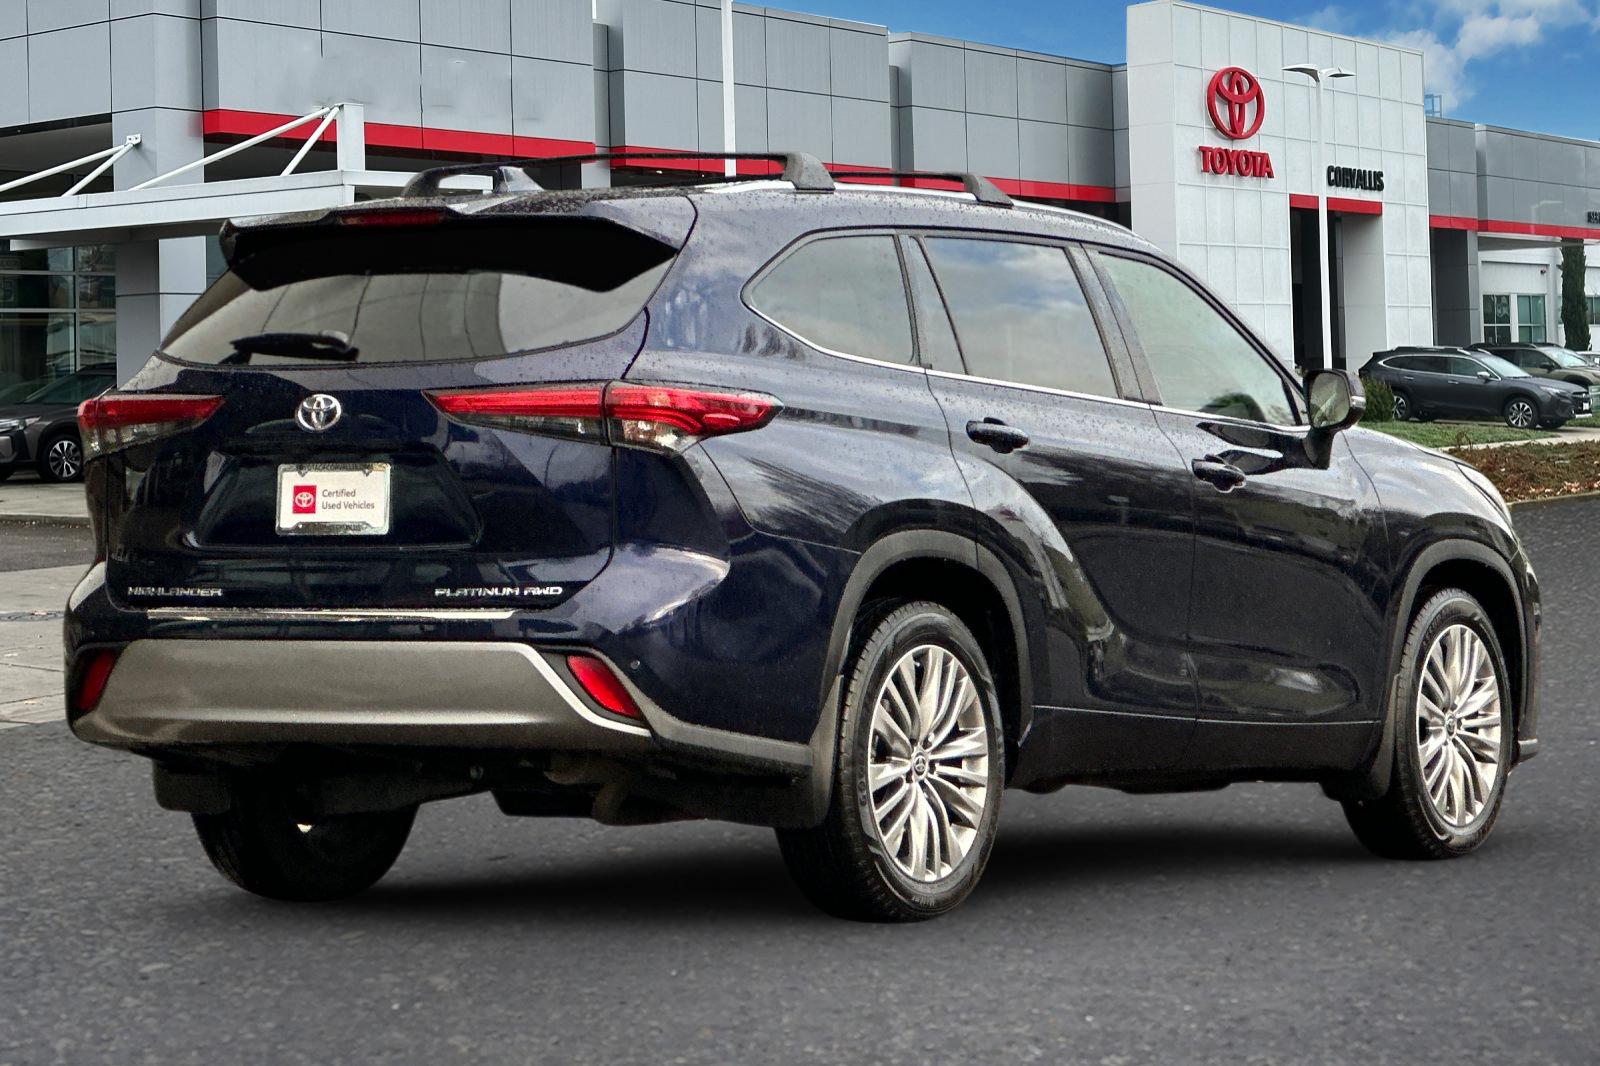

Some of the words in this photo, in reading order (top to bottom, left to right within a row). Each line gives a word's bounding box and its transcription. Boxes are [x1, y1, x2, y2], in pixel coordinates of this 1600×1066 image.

[1199, 146, 1274, 178] TOYOTA
[1327, 165, 1384, 190] CORVALLIS
[322, 488, 356, 498] Certified
[322, 501, 342, 510] Used
[344, 500, 375, 510] Vehicles
[434, 587, 519, 597] PLATINUM
[523, 586, 563, 596] AWD
